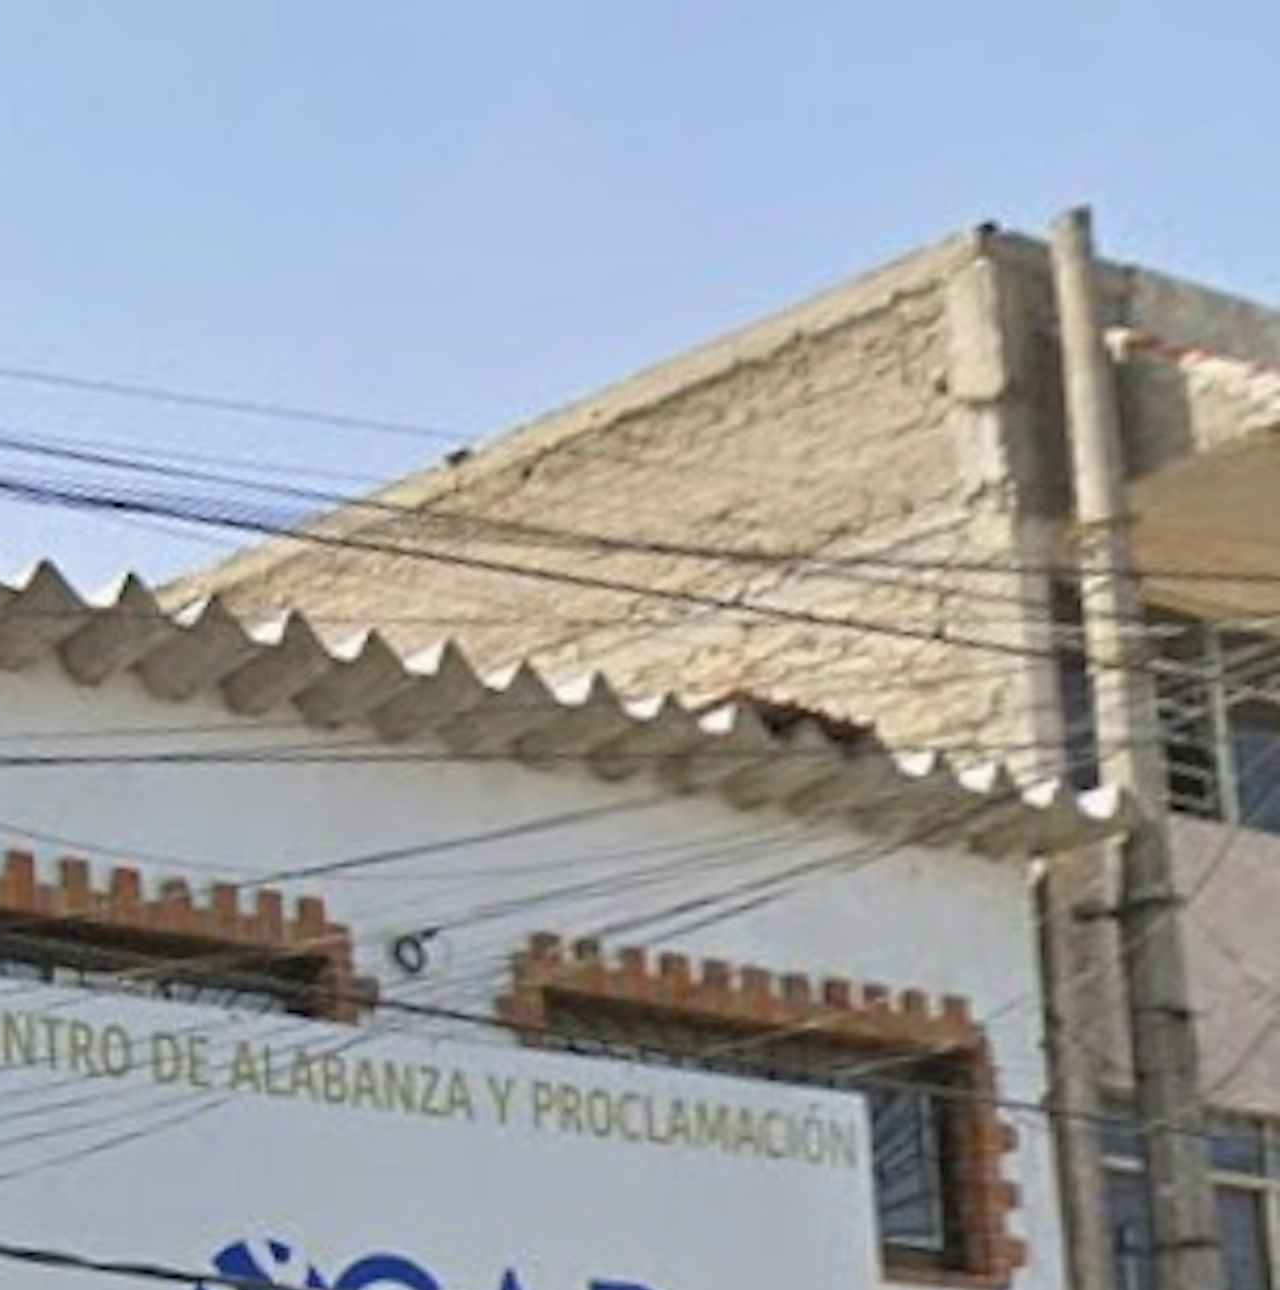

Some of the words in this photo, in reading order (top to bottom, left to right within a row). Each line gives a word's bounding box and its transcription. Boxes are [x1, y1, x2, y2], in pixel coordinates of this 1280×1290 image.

[149, 1032, 211, 1088] DE
[229, 1039, 474, 1121] ALABANZA
[488, 1073, 516, 1126] Y
[533, 1080, 857, 1168] PROCLAMACIÓN
